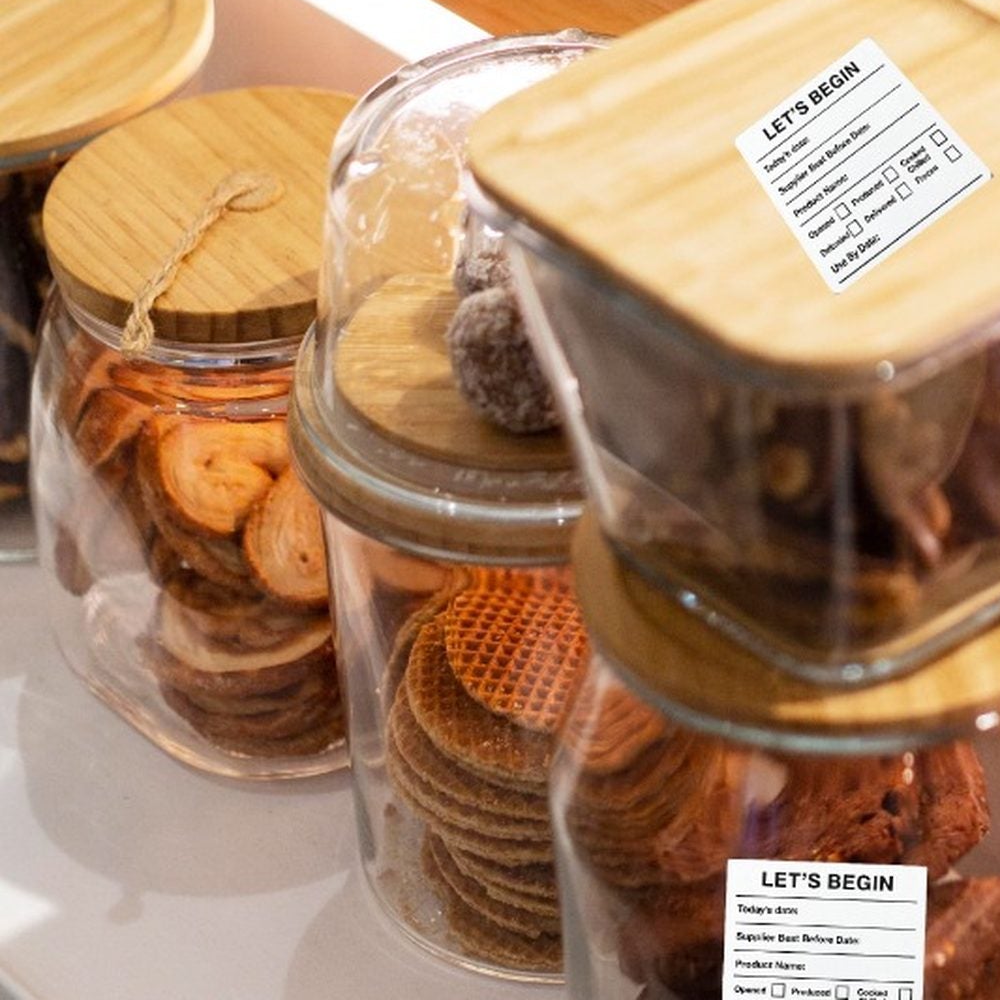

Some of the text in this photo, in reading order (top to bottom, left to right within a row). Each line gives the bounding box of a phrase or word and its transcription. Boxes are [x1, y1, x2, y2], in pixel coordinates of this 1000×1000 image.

[763, 61, 860, 140] LET'S BEGIN
[762, 872, 894, 891] LET'S BEGIN
